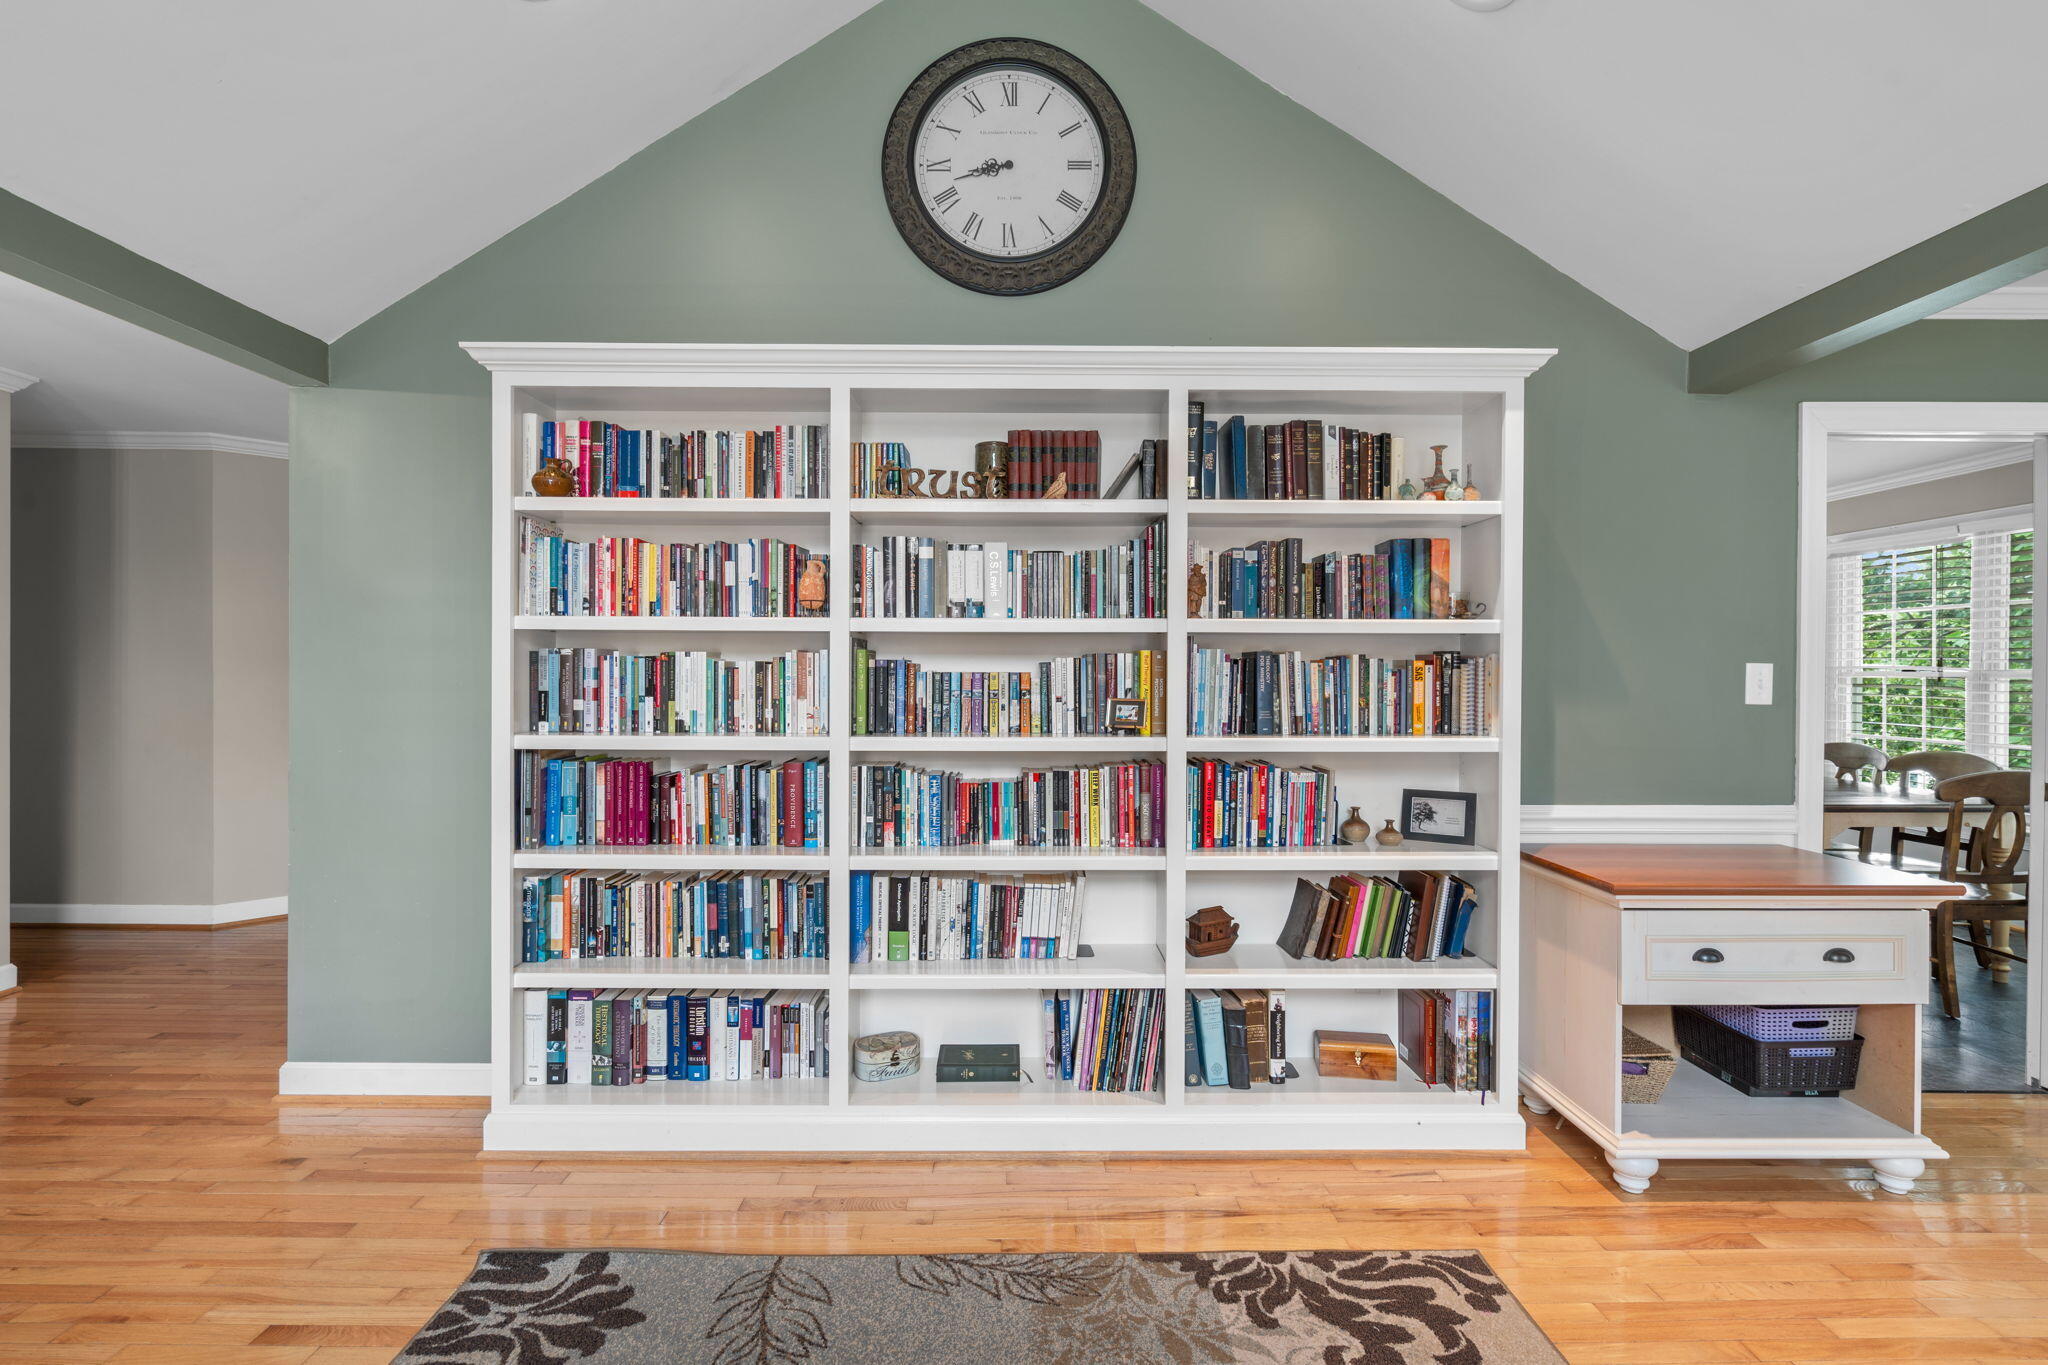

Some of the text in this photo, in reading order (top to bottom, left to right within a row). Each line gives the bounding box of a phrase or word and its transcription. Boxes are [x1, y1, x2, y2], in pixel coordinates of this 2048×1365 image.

[1000, 82, 1018, 106] XII
[1036, 93, 1052, 114] I
[936, 120, 962, 141] X
[1058, 122, 1082, 138] II
[1068, 160, 1092, 170] III
[1038, 215, 1055, 239] V
[1415, 666, 1424, 681] SAS
[1207, 804, 1212, 813] TO
[601, 1005, 609, 1046] HISTORICAL
[695, 1007, 706, 1036] Christian
